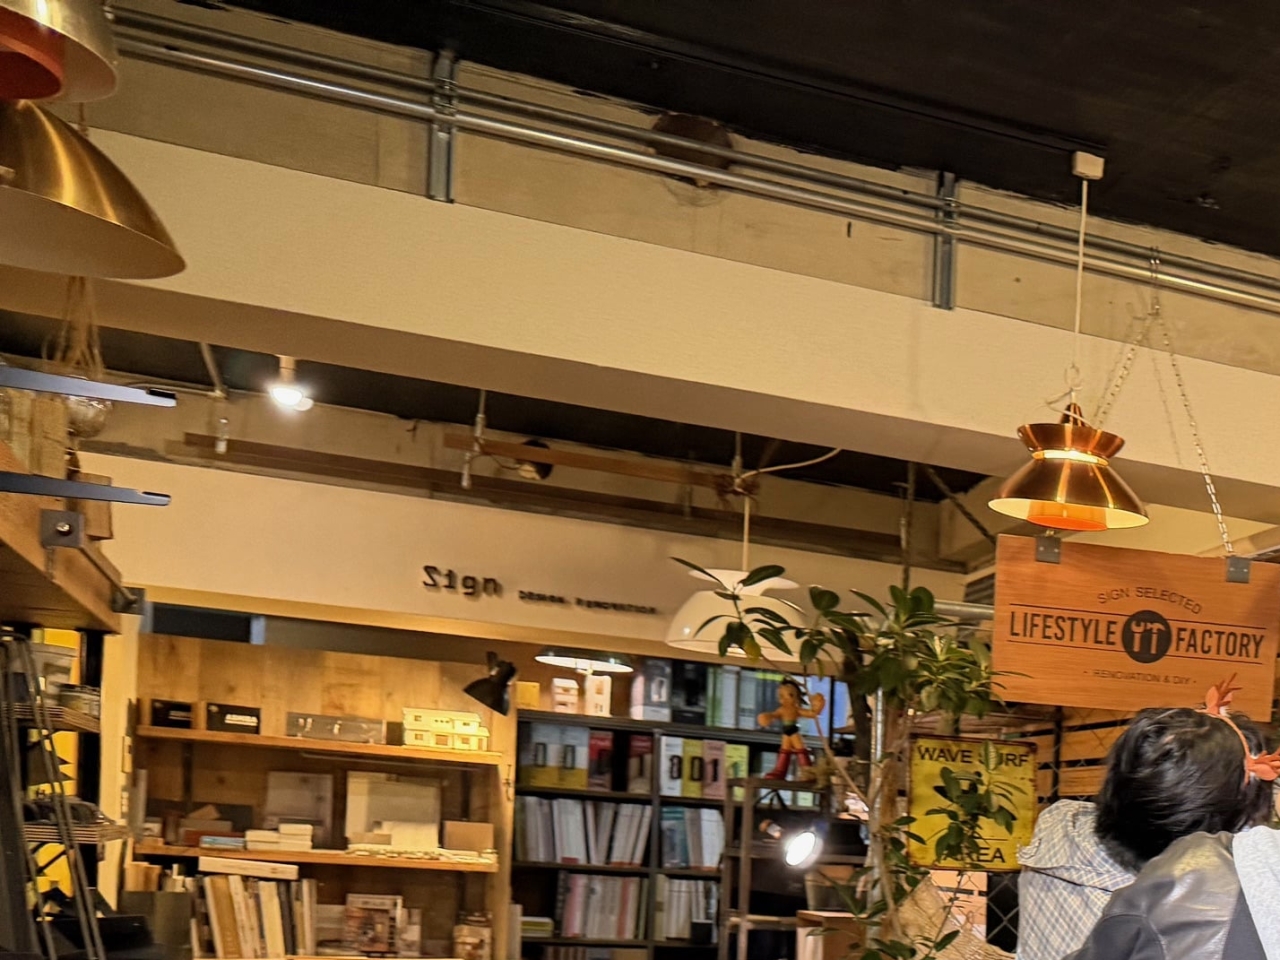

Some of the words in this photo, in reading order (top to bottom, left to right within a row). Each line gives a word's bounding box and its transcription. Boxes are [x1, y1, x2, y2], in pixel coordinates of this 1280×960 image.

[1097, 588, 1130, 604] SIGN
[1135, 586, 1202, 614] SELECTED
[1010, 611, 1117, 645] LIFESTYLE
[1175, 627, 1265, 659] FACTORY
[917, 745, 973, 764] WAVE
